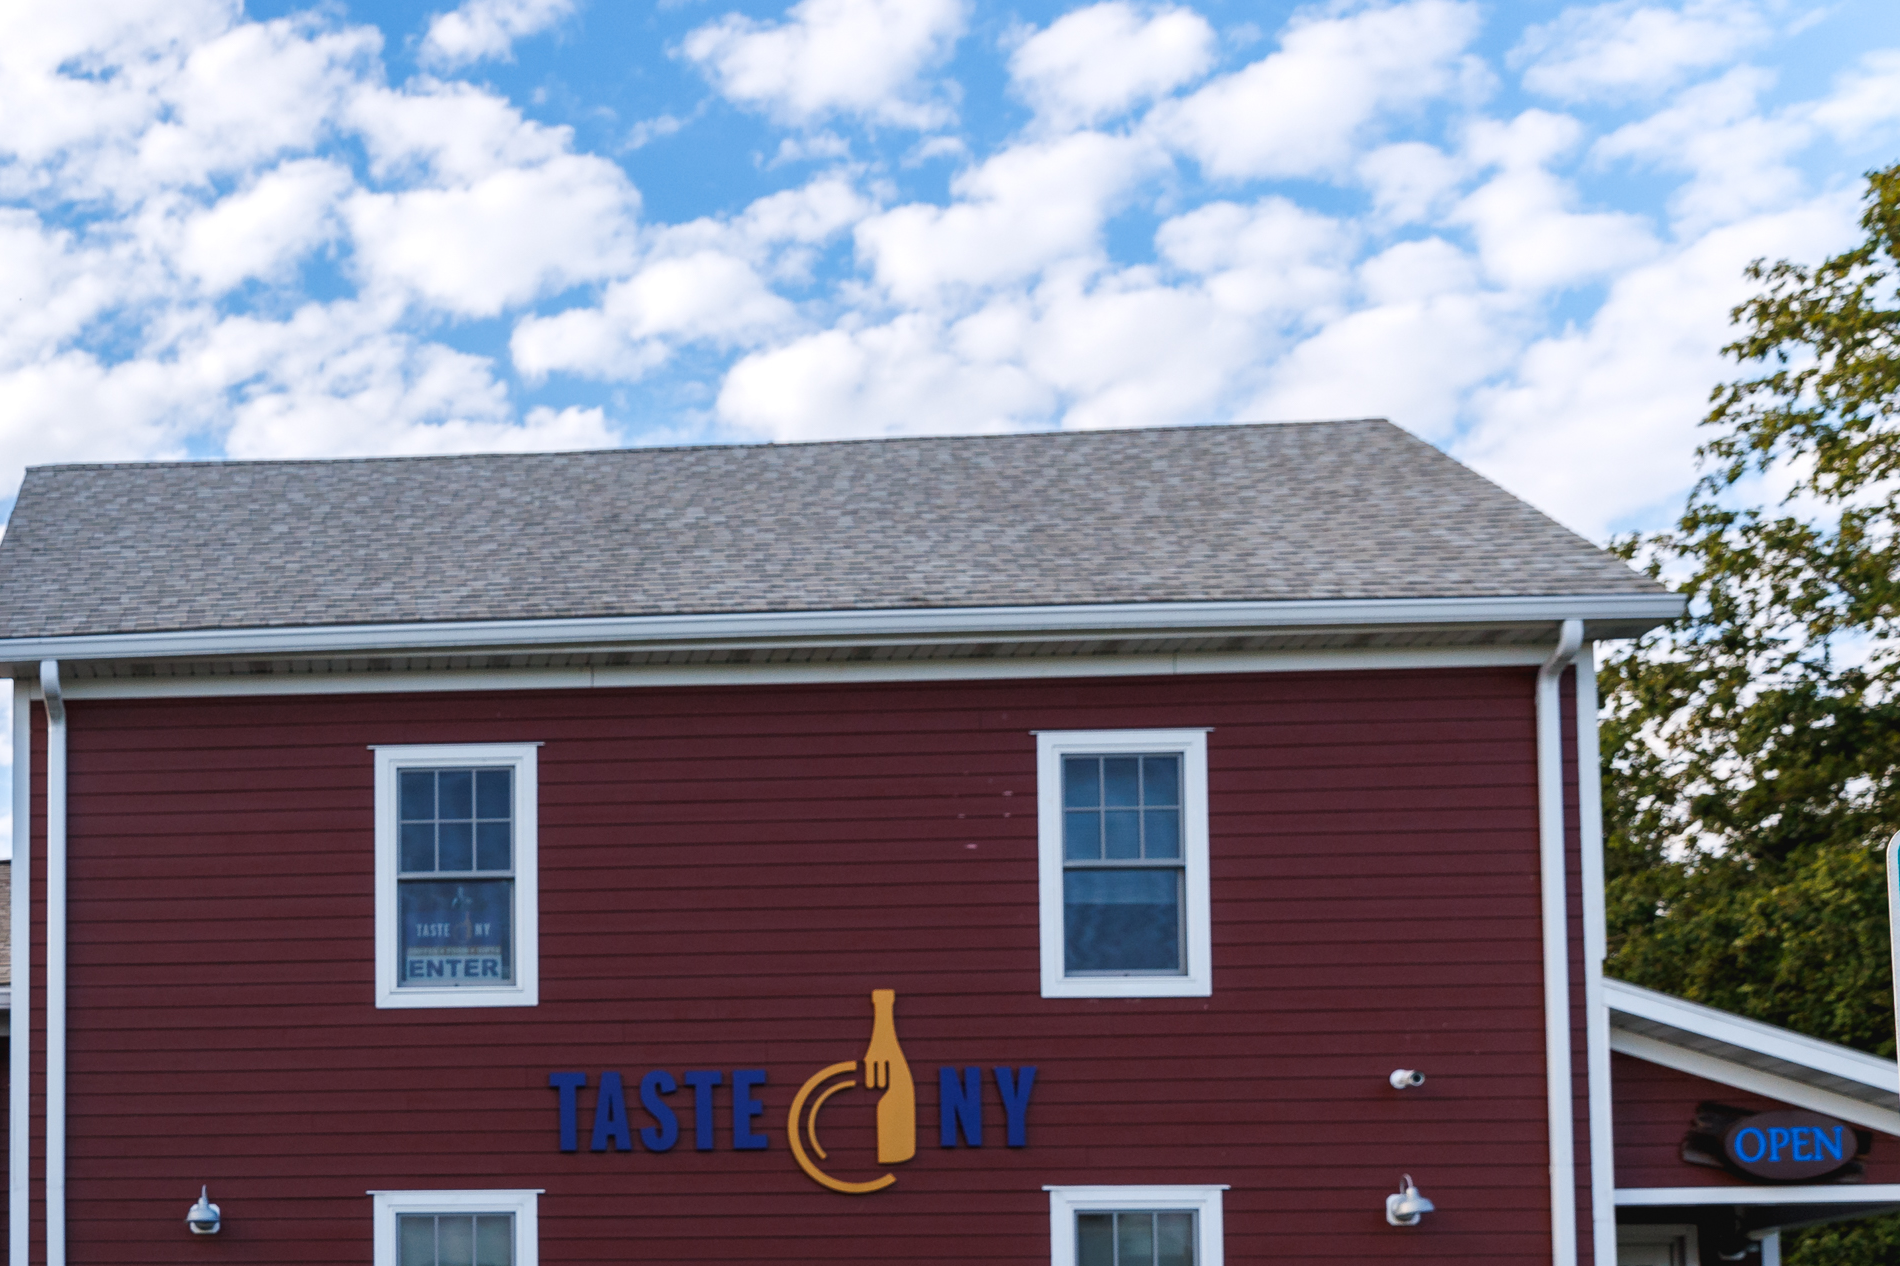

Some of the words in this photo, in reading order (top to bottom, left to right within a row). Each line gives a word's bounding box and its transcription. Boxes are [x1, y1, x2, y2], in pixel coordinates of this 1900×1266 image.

[416, 922, 451, 938] TASTE
[474, 922, 491, 938] NY
[409, 958, 499, 978] ENTER
[548, 1069, 769, 1152] TASTE
[938, 1065, 1038, 1148] NY
[1734, 1126, 1843, 1163] OPEN
